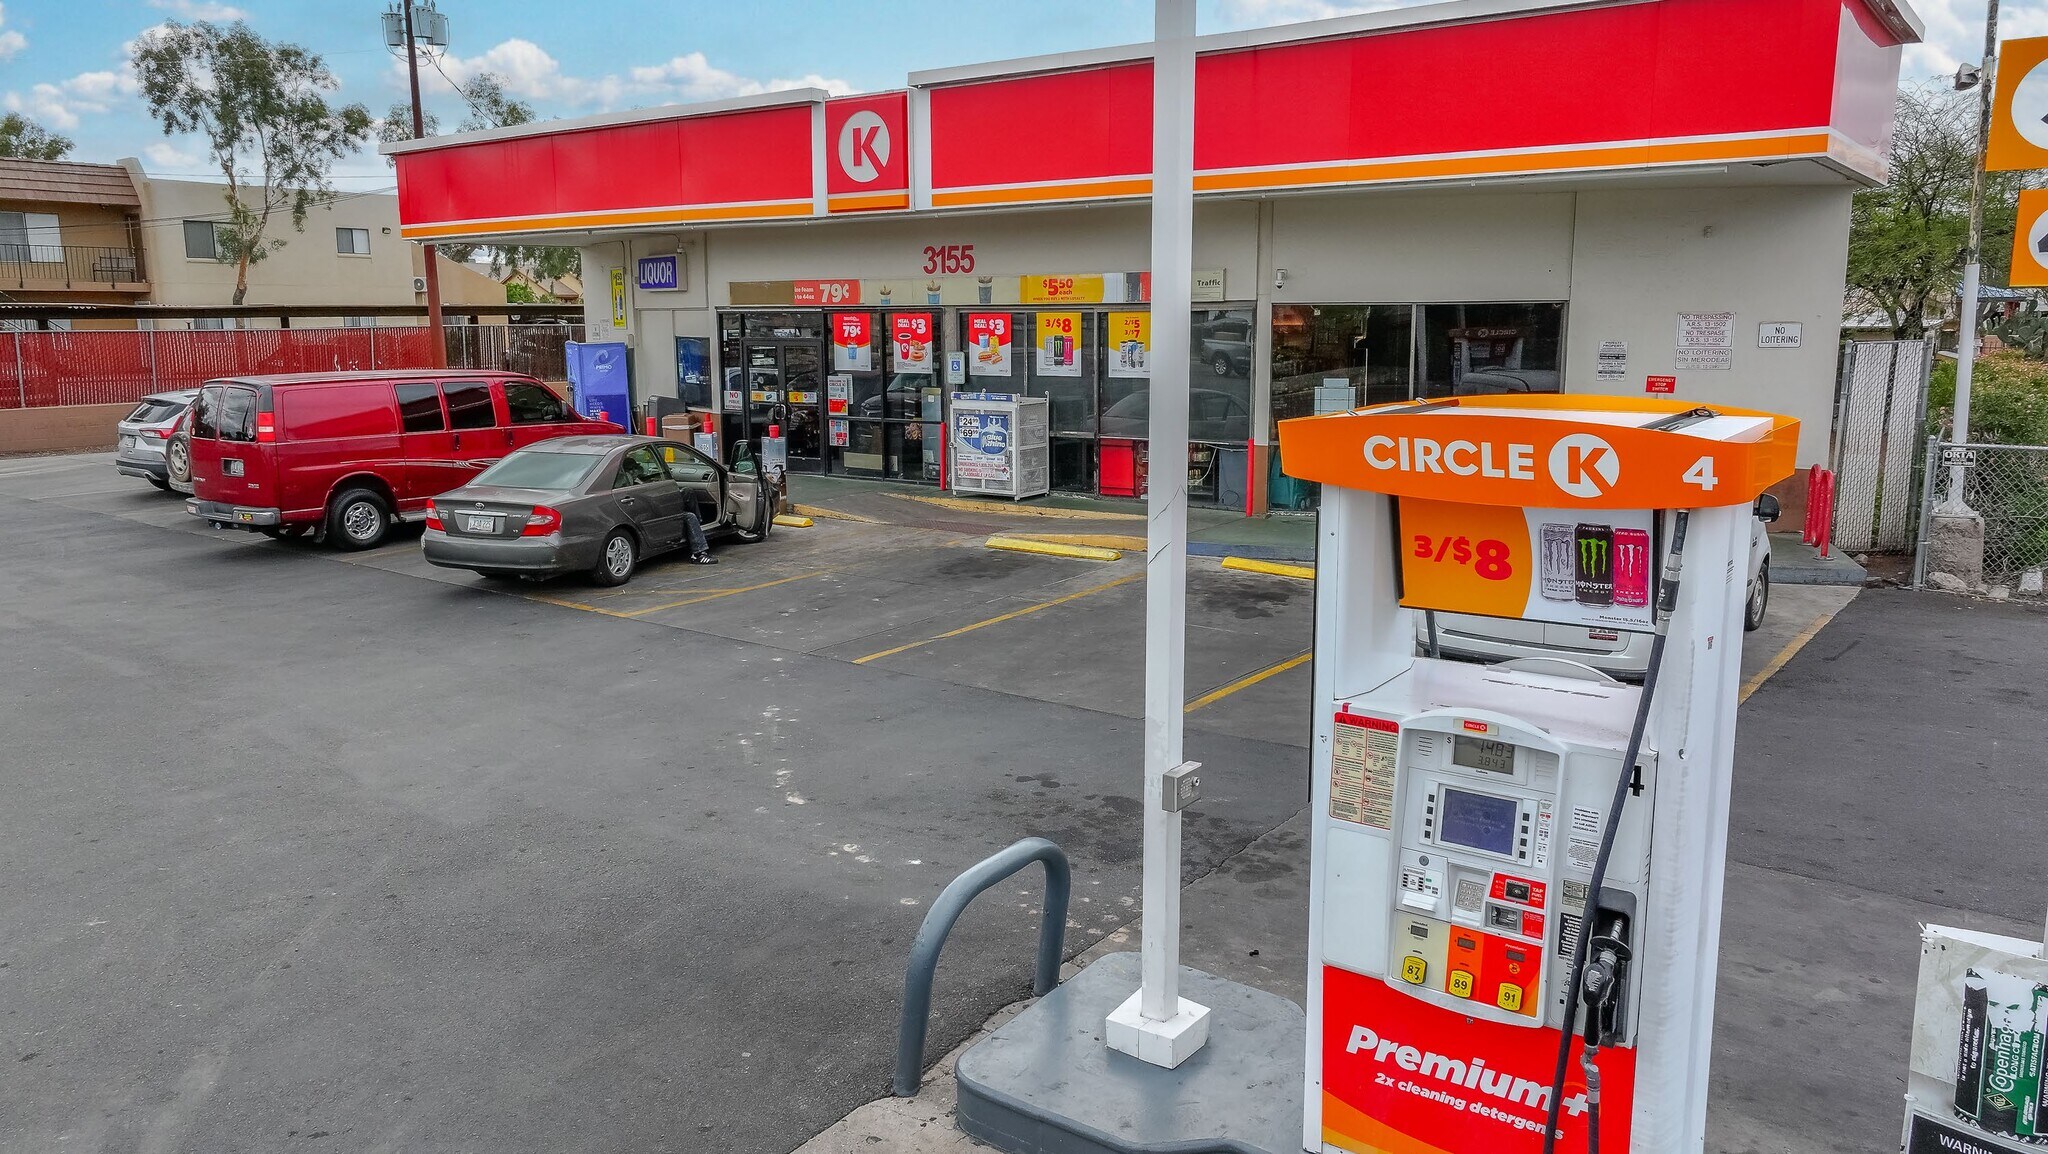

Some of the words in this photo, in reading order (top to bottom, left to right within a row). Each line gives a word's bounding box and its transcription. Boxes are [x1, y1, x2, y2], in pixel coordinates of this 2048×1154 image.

[852, 125, 887, 180] K
[922, 245, 975, 274] 3155
[640, 261, 673, 285] LIQUOR
[819, 283, 849, 303] 79¢
[911, 318, 926, 334] $3
[989, 319, 1005, 335] $3
[1045, 317, 1073, 333] 3/$8
[1124, 319, 1140, 329] 2/$5
[1774, 326, 1786, 335] NO
[842, 325, 862, 338] 79¢
[1124, 329, 1141, 338] 3/$7
[1761, 335, 1799, 344] LOITERING
[729, 391, 739, 399] NO
[985, 439, 1005, 448] Rhino
[1944, 451, 1974, 459] ORTA
[1363, 435, 1535, 480] CIRCLE
[1565, 443, 1616, 496] K
[1681, 456, 1719, 491] 4
[1414, 535, 1513, 581] 3/$8
[1576, 580, 1613, 590] MONSTER
[1349, 717, 1397, 731] WARNING
[1446, 736, 1452, 744] $
[1478, 756, 1506, 769] 3.843
[1628, 765, 1645, 797] 4
[1504, 943, 1527, 952] Premium+
[1407, 964, 1421, 976] 87
[1453, 978, 1468, 990] 89
[1504, 992, 1516, 1003] 91
[2009, 1055, 2020, 1079] LONG
[1374, 1072, 1395, 1088] 2x
[1397, 1079, 1467, 1112] cleaning
[1468, 1102, 1564, 1141] detergens
